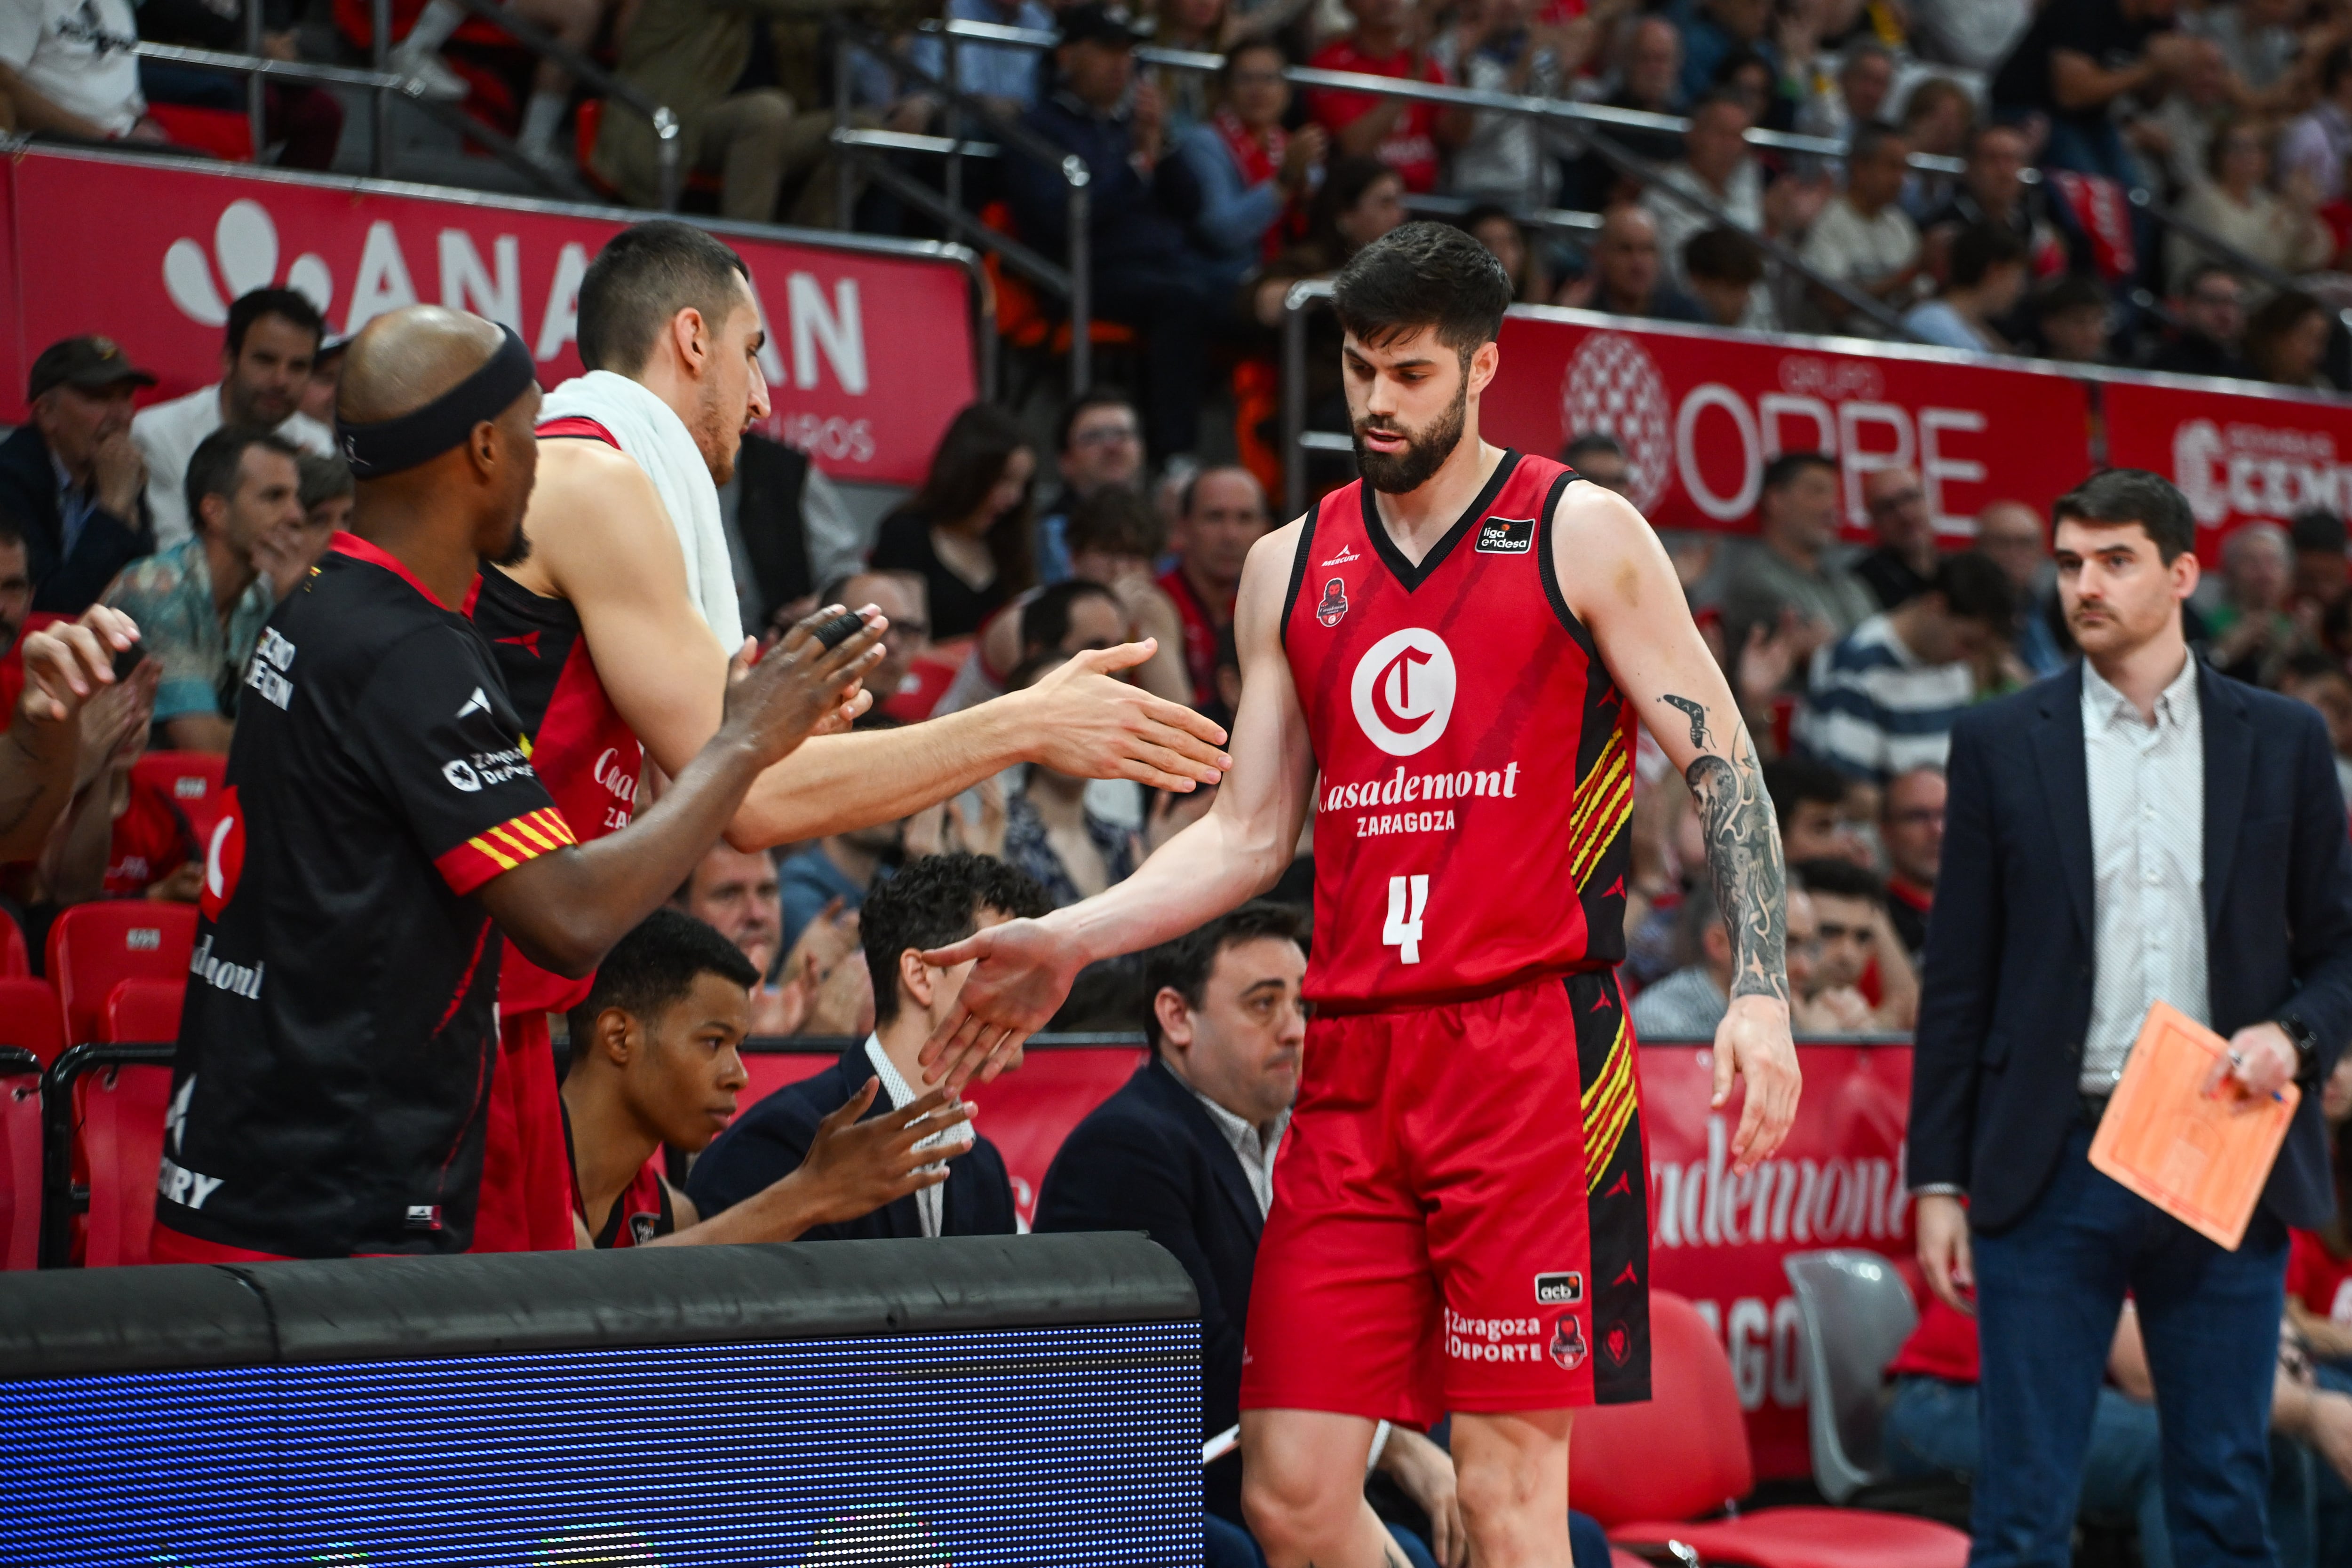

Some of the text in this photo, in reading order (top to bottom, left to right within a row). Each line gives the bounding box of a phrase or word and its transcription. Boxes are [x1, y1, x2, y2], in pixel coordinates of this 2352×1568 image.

[1481, 538, 1527, 549] endesa
[1483, 527, 1506, 539] liga
[1321, 554, 1361, 567] MERCURY
[1357, 809, 1455, 837] ZARAGOZA
[1382, 874, 1430, 965] 4
[1541, 1283, 1572, 1300] acb
[1452, 1311, 1541, 1343] Zaragoza
[1451, 1334, 1542, 1362] DEPORTE
